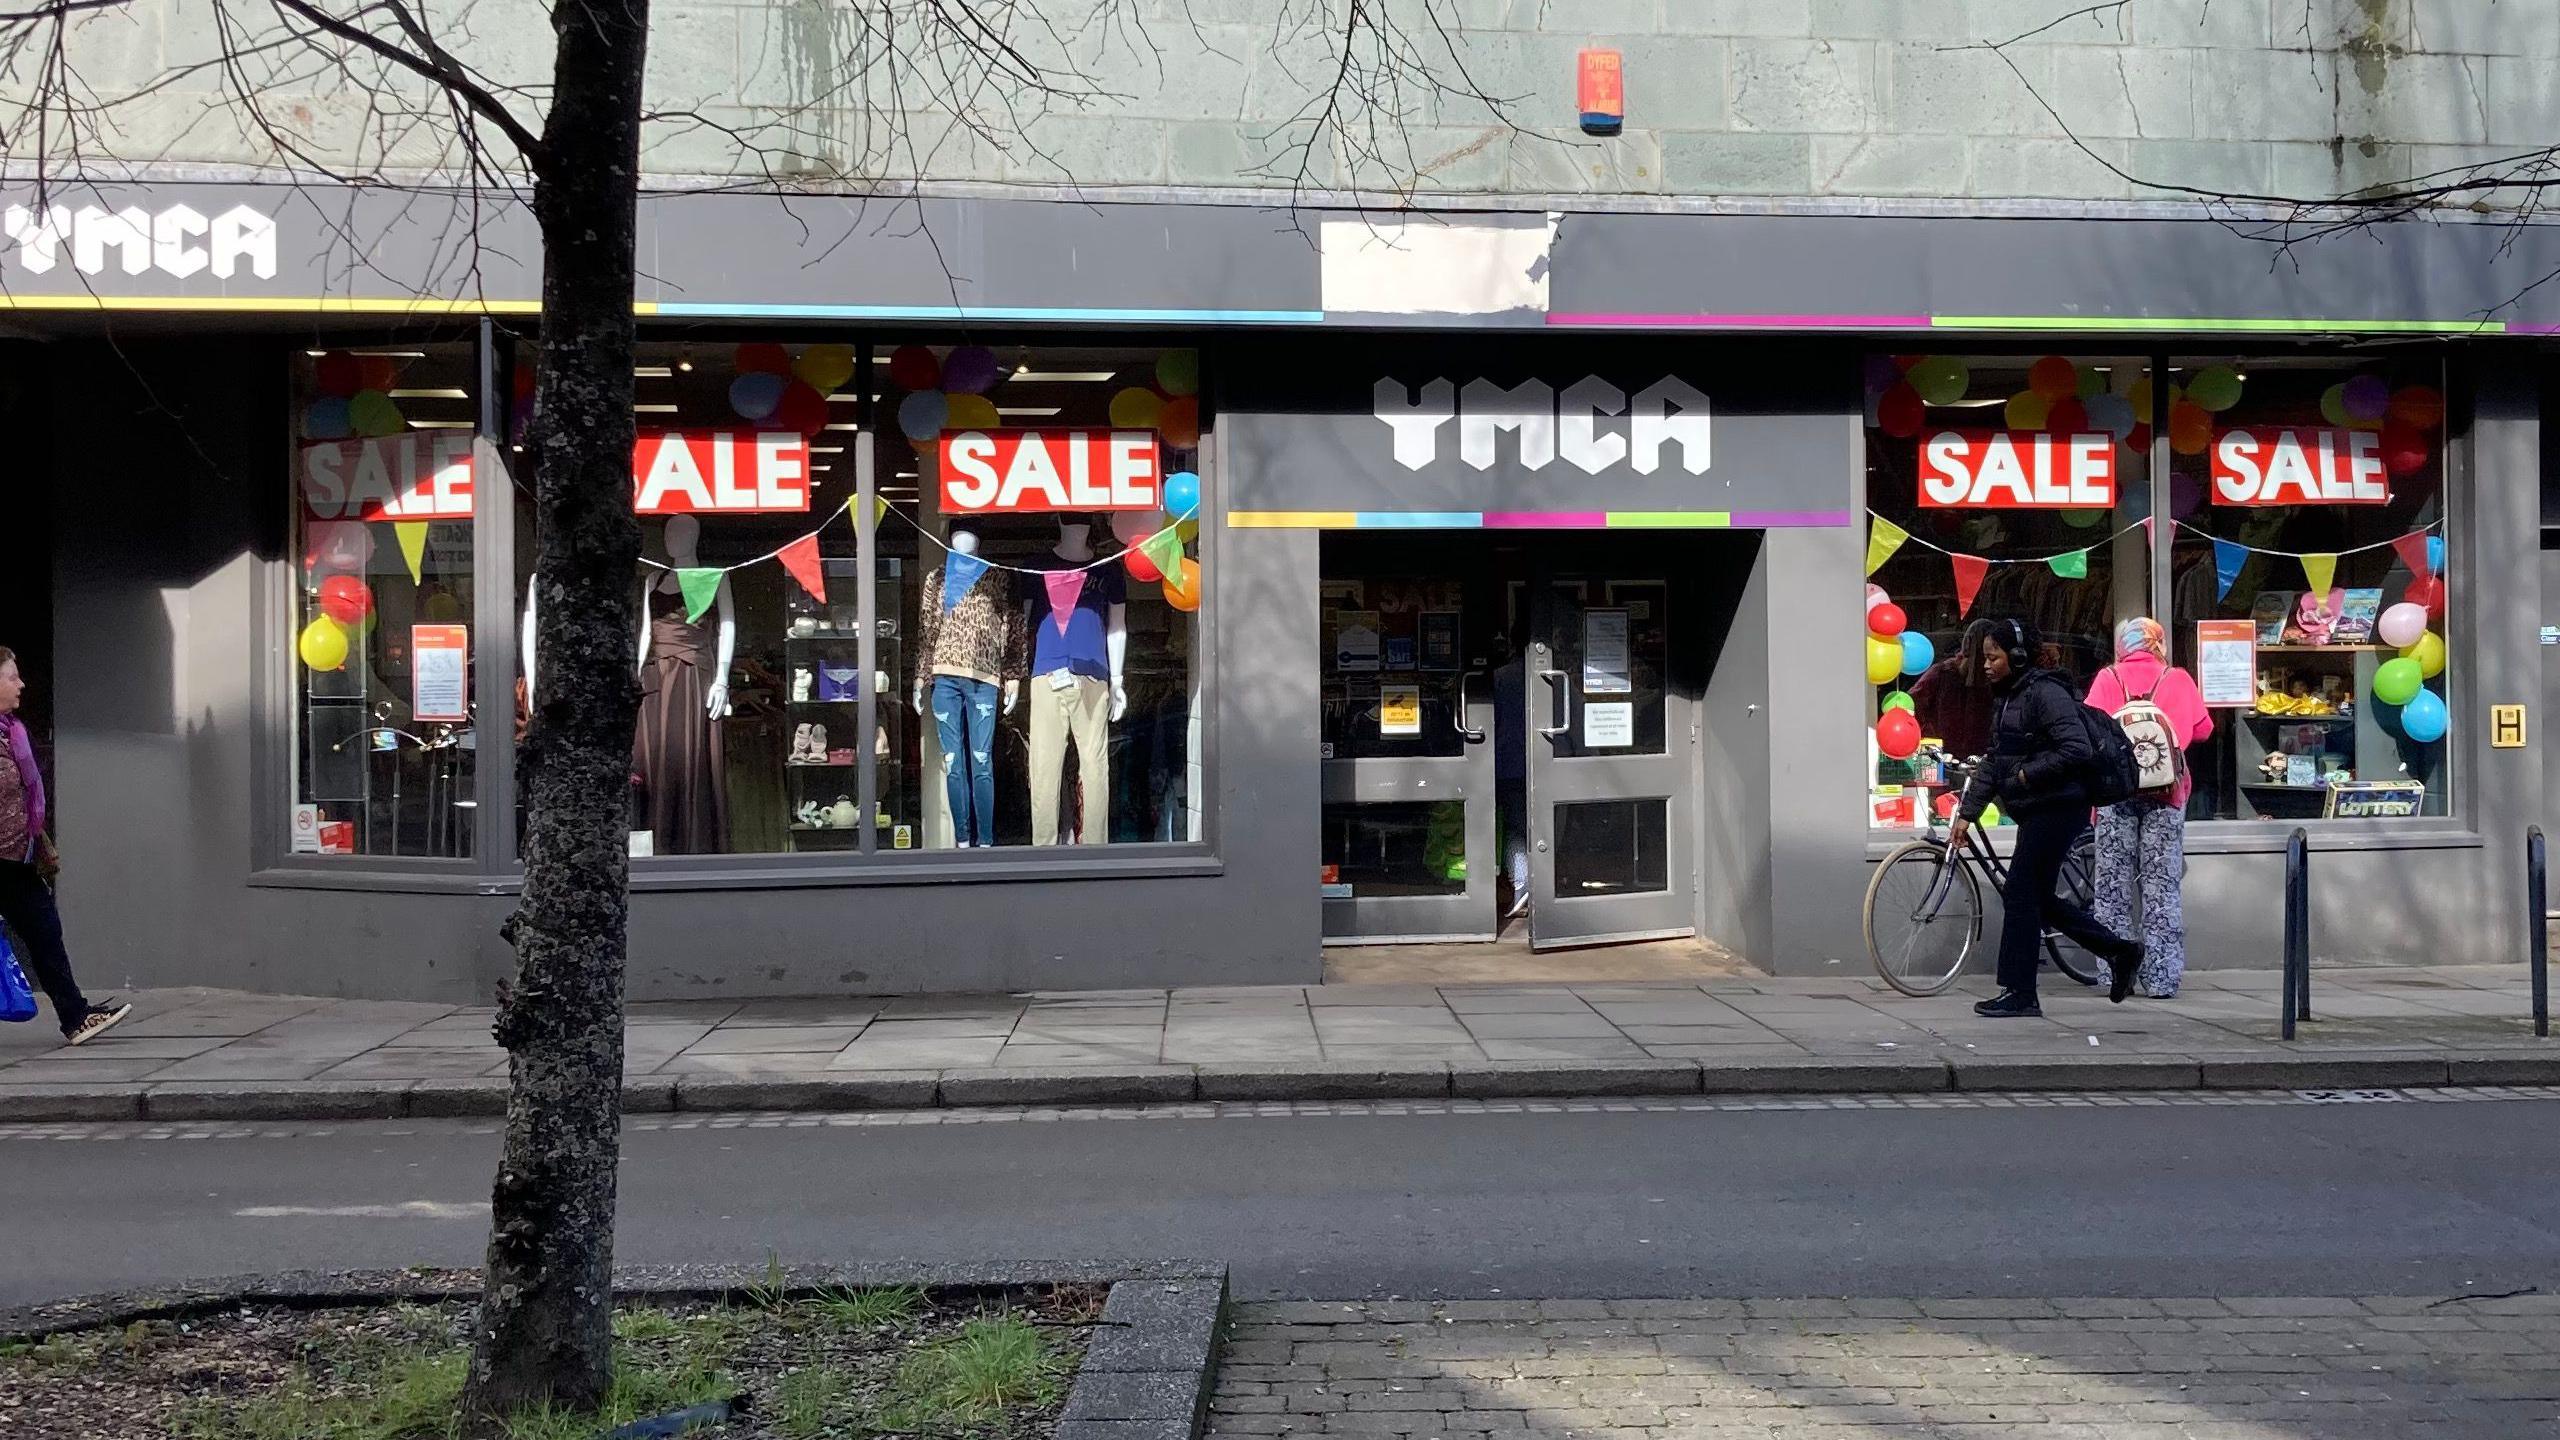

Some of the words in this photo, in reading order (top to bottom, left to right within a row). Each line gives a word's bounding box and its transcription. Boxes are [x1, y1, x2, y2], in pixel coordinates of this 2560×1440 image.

[4, 203, 277, 279] YMCA
[1374, 374, 1711, 475] YMCA
[305, 435, 472, 519] SALE
[633, 431, 803, 508] ALE
[947, 431, 1154, 508] SALE
[1924, 431, 2110, 504] SALE
[2216, 430, 2386, 502] SALE
[2497, 710, 2521, 742] H
[2339, 802, 2417, 816] LOTTERY
